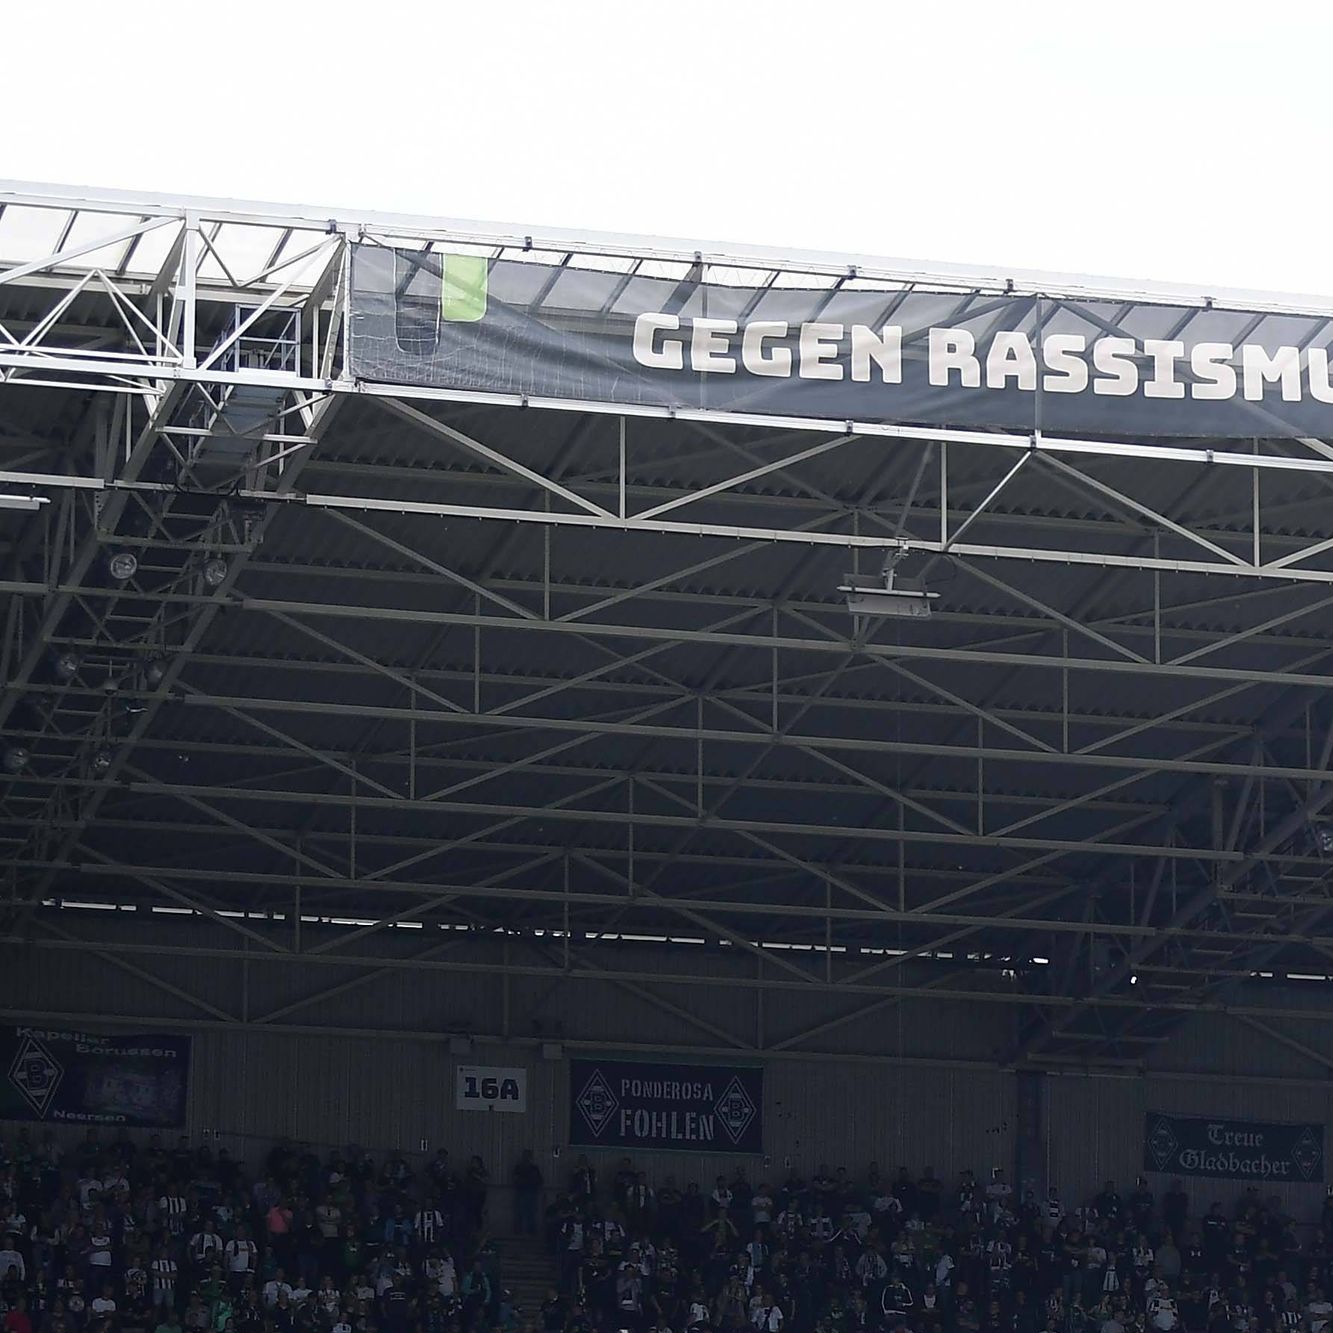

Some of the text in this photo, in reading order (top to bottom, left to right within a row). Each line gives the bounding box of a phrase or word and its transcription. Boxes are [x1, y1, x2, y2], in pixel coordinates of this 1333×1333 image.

[631, 312, 902, 384] GEGEN
[463, 1075, 521, 1100] 16A
[621, 1078, 714, 1102] PONDEROSA
[620, 1111, 715, 1142] FOHLEN
[1207, 1125, 1265, 1147] Treue
[1179, 1148, 1291, 1177] Gladbacher
